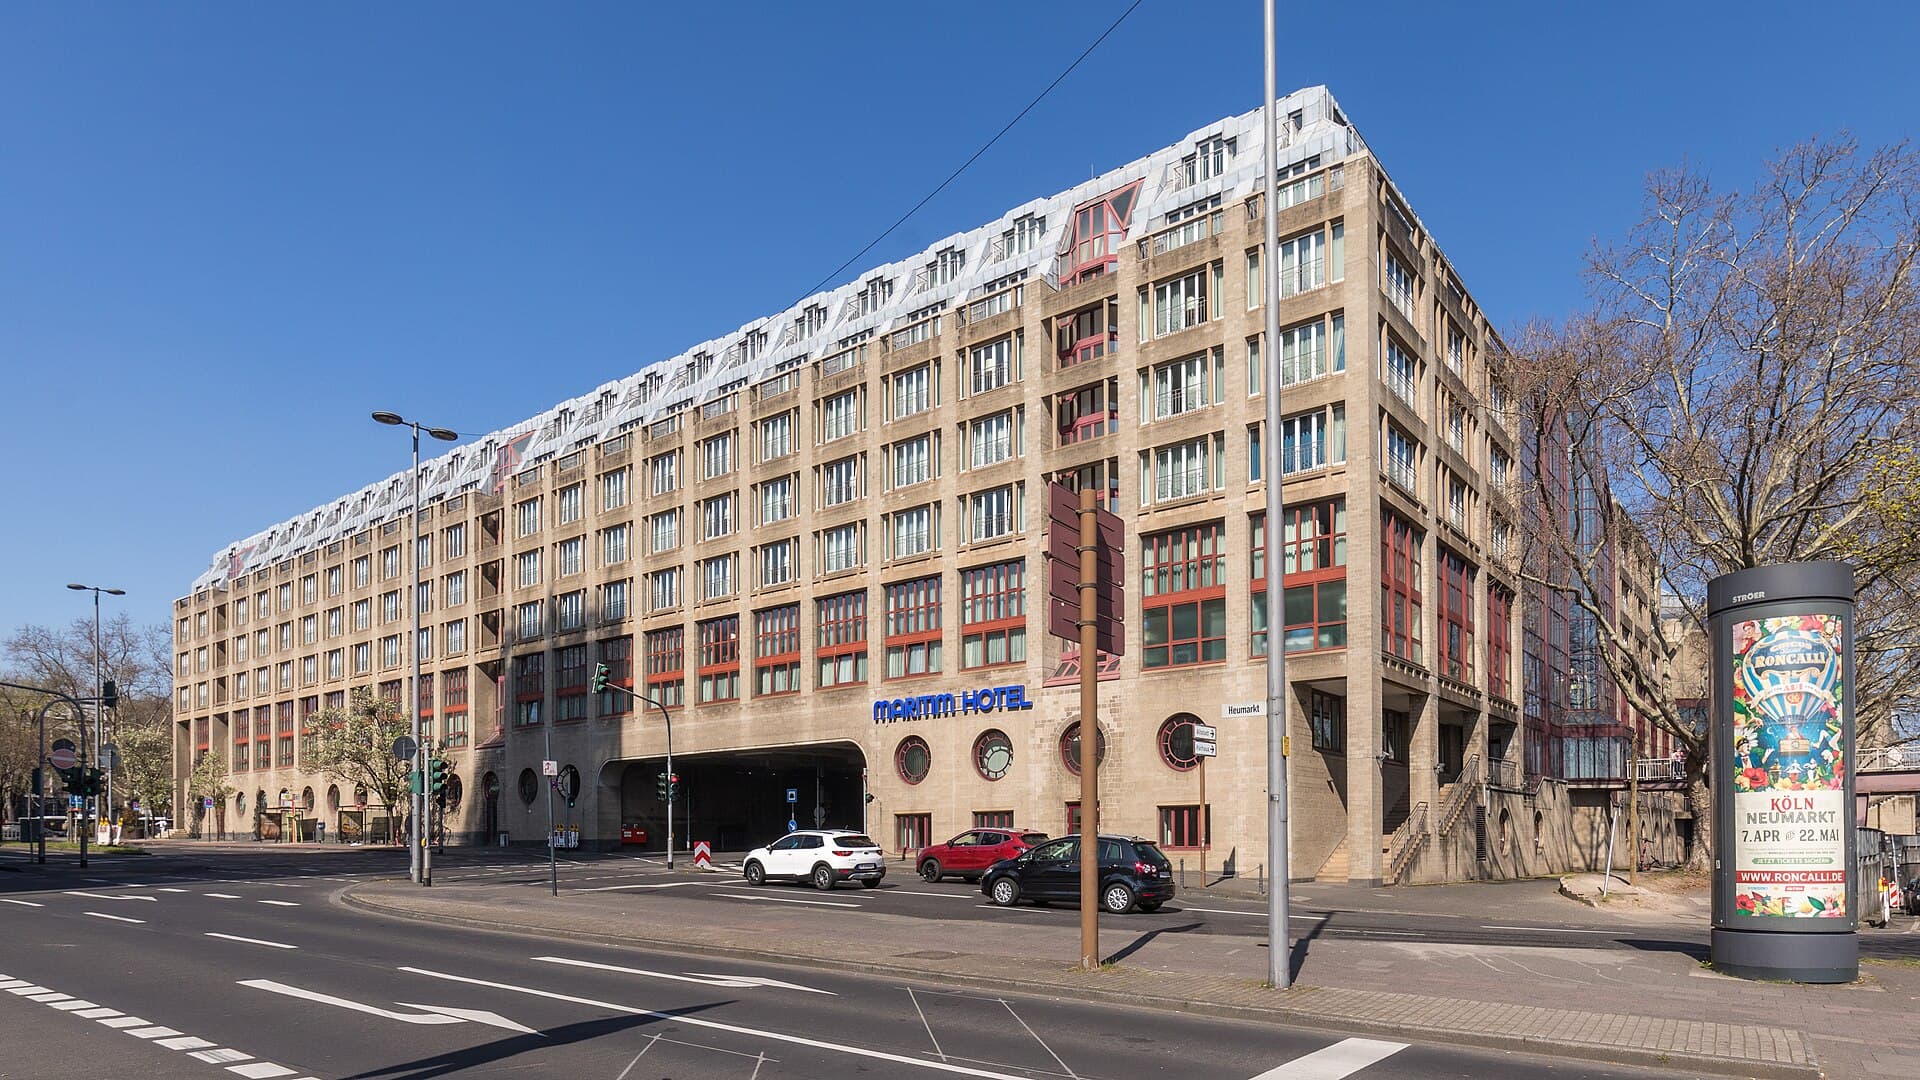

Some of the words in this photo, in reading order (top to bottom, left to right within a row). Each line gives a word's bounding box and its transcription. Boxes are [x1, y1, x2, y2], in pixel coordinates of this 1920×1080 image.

[1754, 652, 1826, 668] RONCALLI
[873, 693, 955, 721] MARITIM
[962, 685, 1033, 712] HOTEL
[1228, 705, 1260, 714] Heumarkt
[1771, 795, 1814, 814] KÖLN
[1746, 811, 1836, 824] NEUMARKT
[1741, 872, 1843, 882] WWW.RONCALLI.DE
